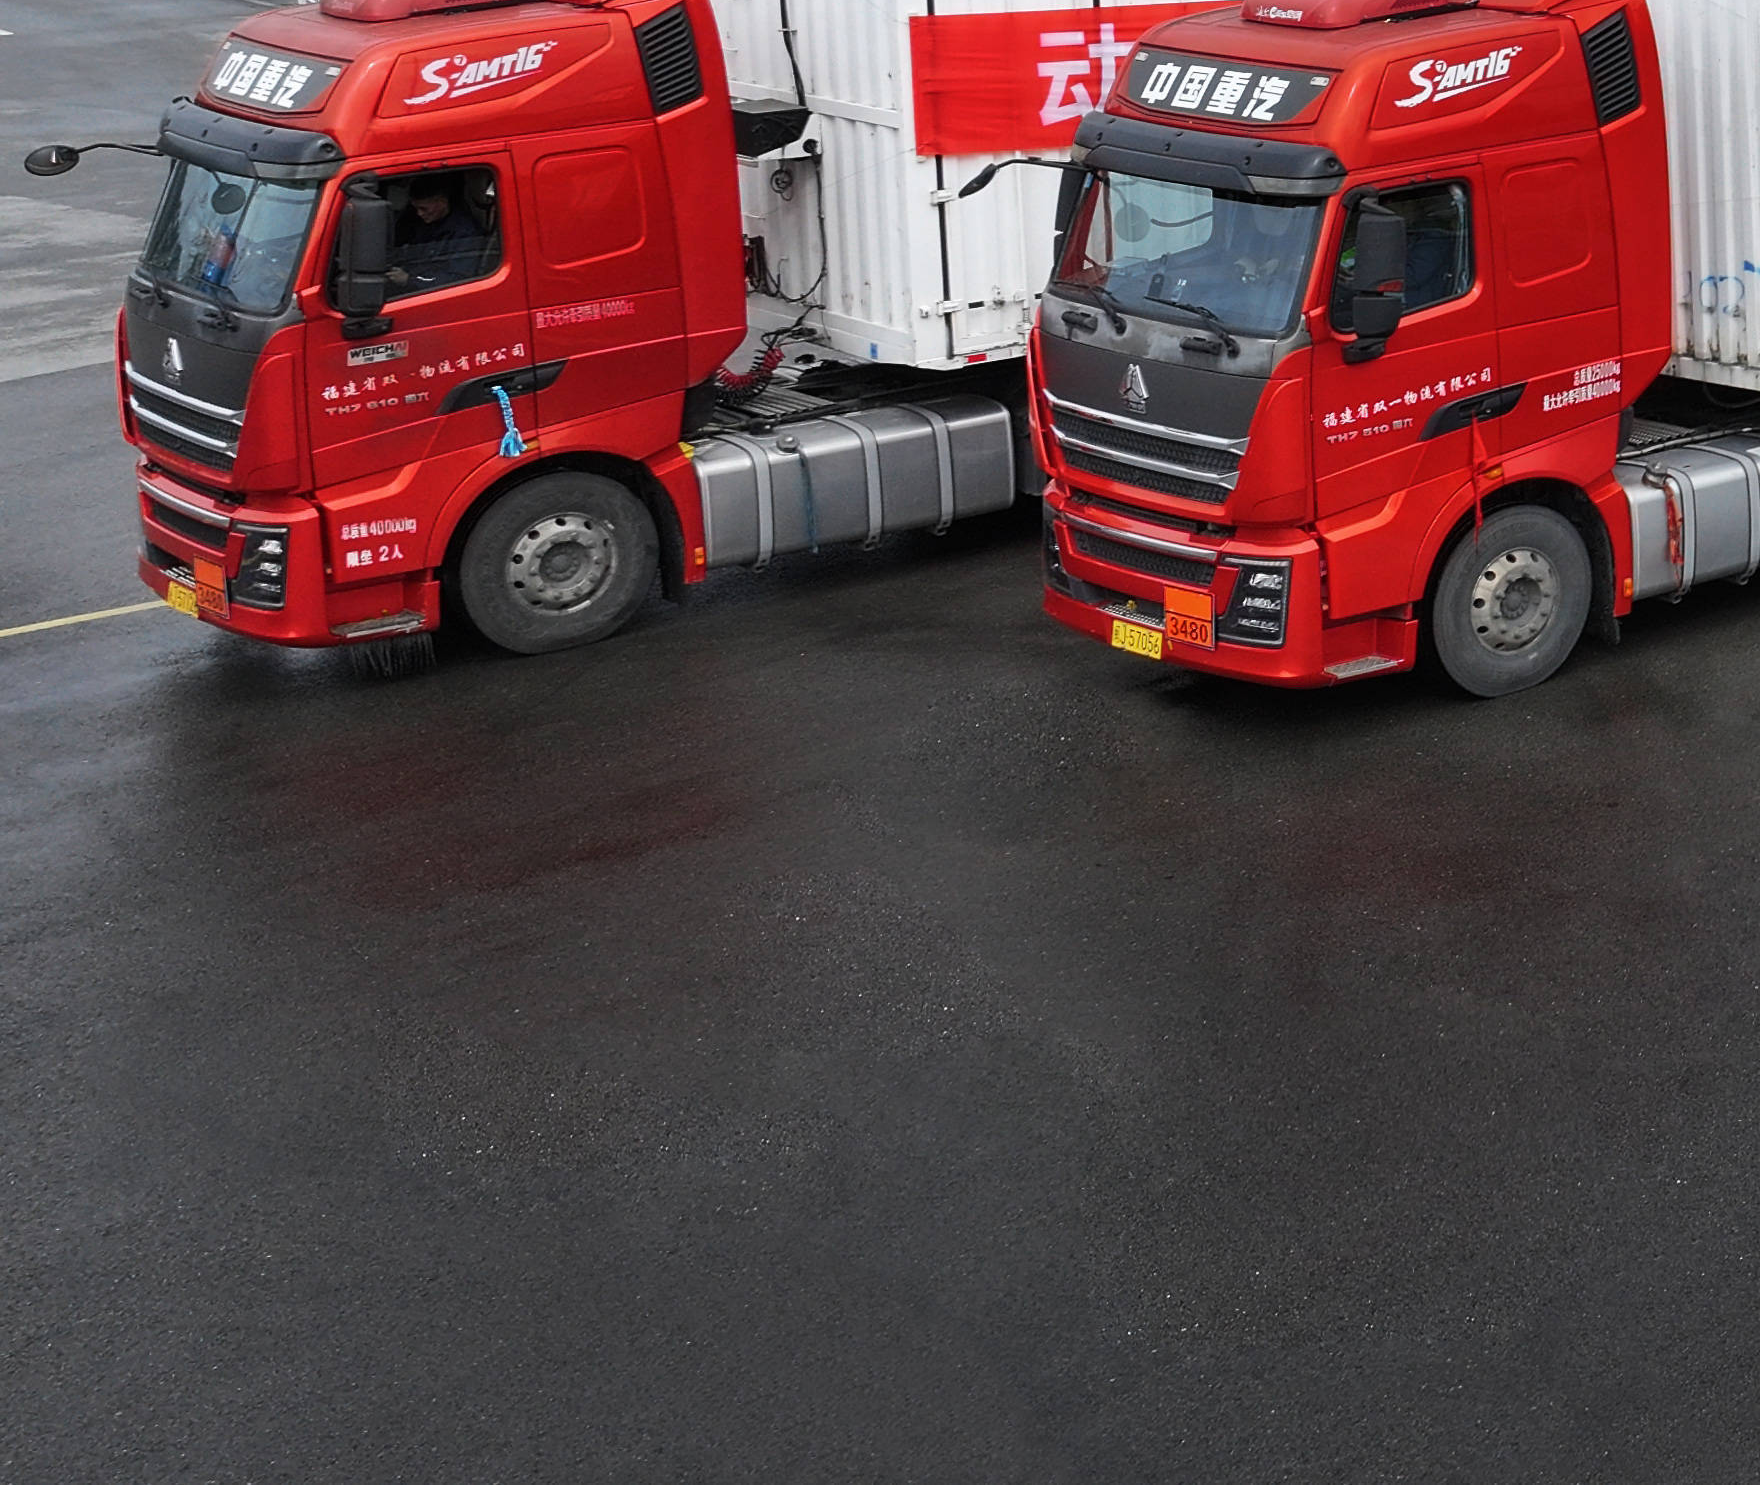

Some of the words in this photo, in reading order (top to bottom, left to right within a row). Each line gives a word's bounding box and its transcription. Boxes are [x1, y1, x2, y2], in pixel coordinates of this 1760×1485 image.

[212, 51, 314, 109] 中国重汽
[1139, 61, 1290, 122] 中国重汽
[350, 342, 408, 360] WEICHAI
[1322, 367, 1492, 429] 福建省双一物流有限公司
[1326, 430, 1358, 445] TH7
[1169, 616, 1209, 644] 3480
